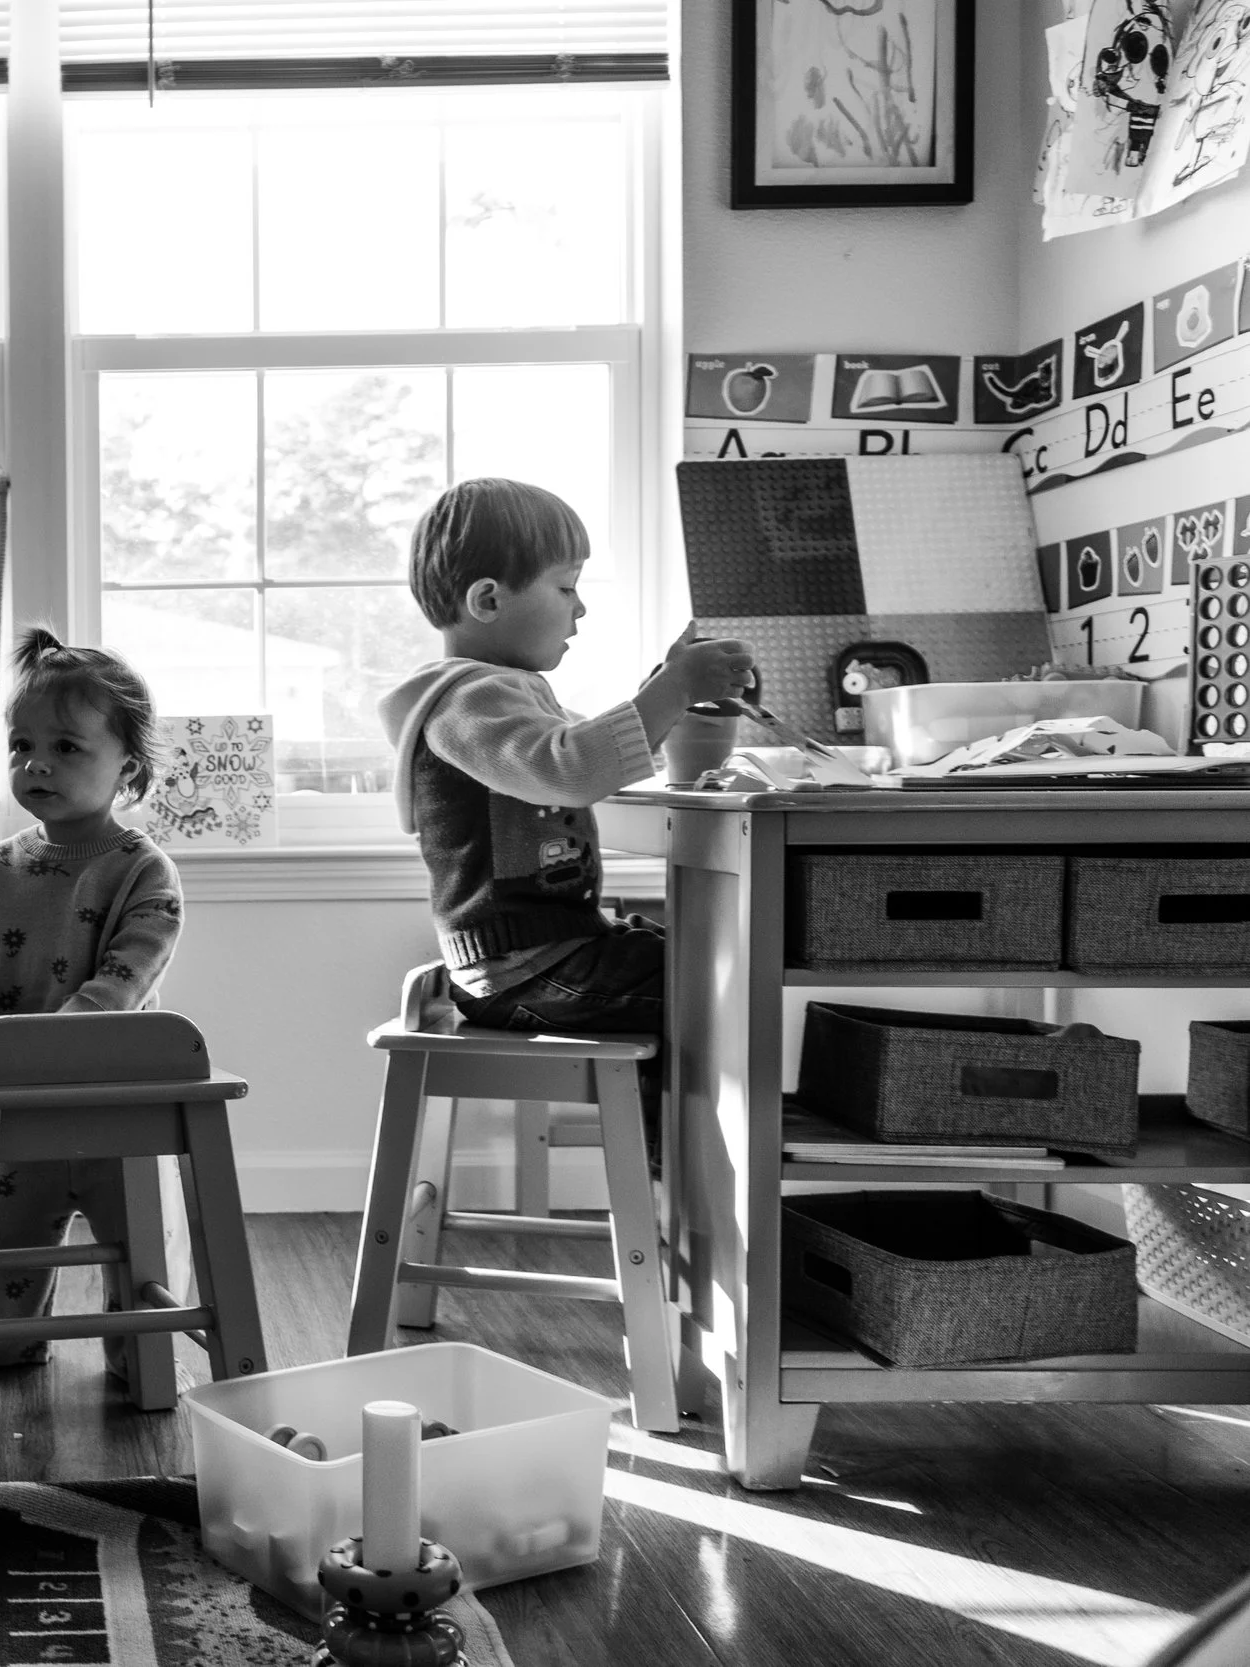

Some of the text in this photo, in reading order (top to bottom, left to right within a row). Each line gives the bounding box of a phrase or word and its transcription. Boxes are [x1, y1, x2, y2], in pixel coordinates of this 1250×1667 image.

[1084, 391, 1128, 458] Dd
[1172, 367, 1215, 429] Ee
[1080, 616, 1093, 666] 1
[1129, 607, 1150, 664] 2
[206, 754, 256, 772] SNOW
[214, 774, 247, 785] GOOD
[38, 1610, 72, 1625] 3
